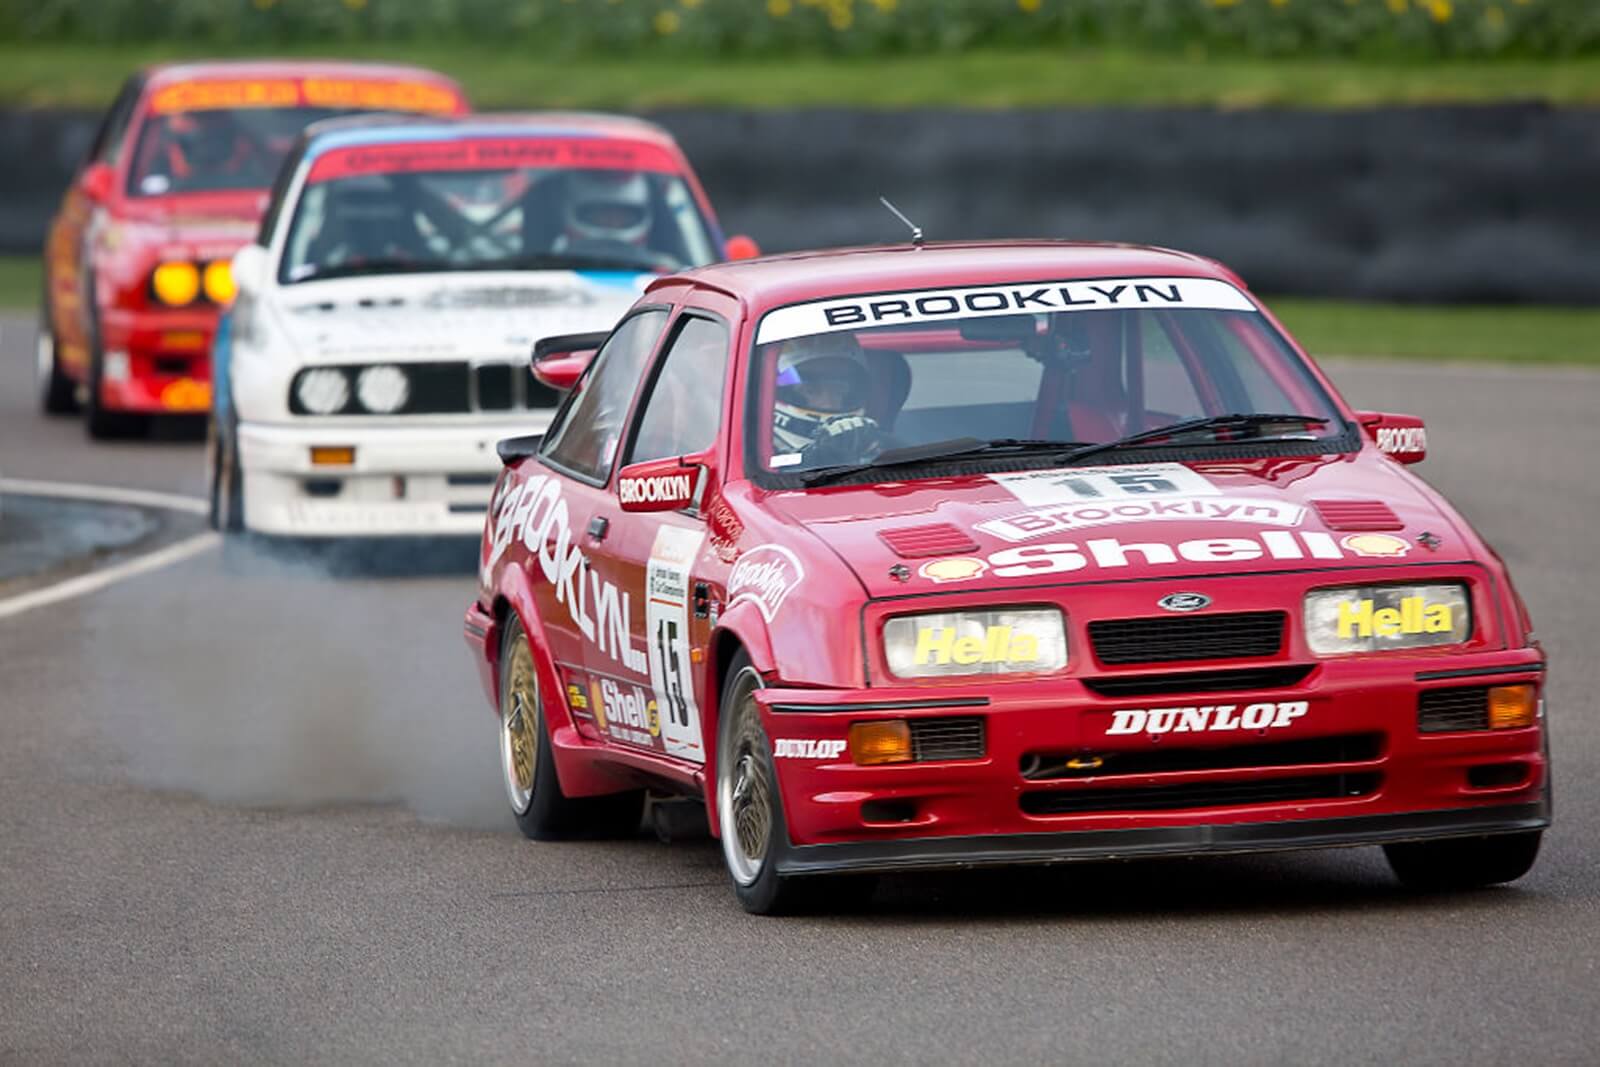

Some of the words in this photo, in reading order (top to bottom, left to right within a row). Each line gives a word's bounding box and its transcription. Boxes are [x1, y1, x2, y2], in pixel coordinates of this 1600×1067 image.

[825, 284, 1184, 327] BROOKLYN
[619, 475, 690, 504] BROOKLYN
[1052, 474, 1180, 498] 15
[1002, 500, 1280, 532] Brooklyn
[988, 530, 1344, 577] Shell
[1337, 597, 1453, 639] Hella
[913, 624, 1039, 665] Hella
[657, 619, 689, 727] 15
[601, 679, 654, 730] Shell
[1105, 701, 1309, 735] DUNLOP
[774, 738, 848, 759] DUNLOP
